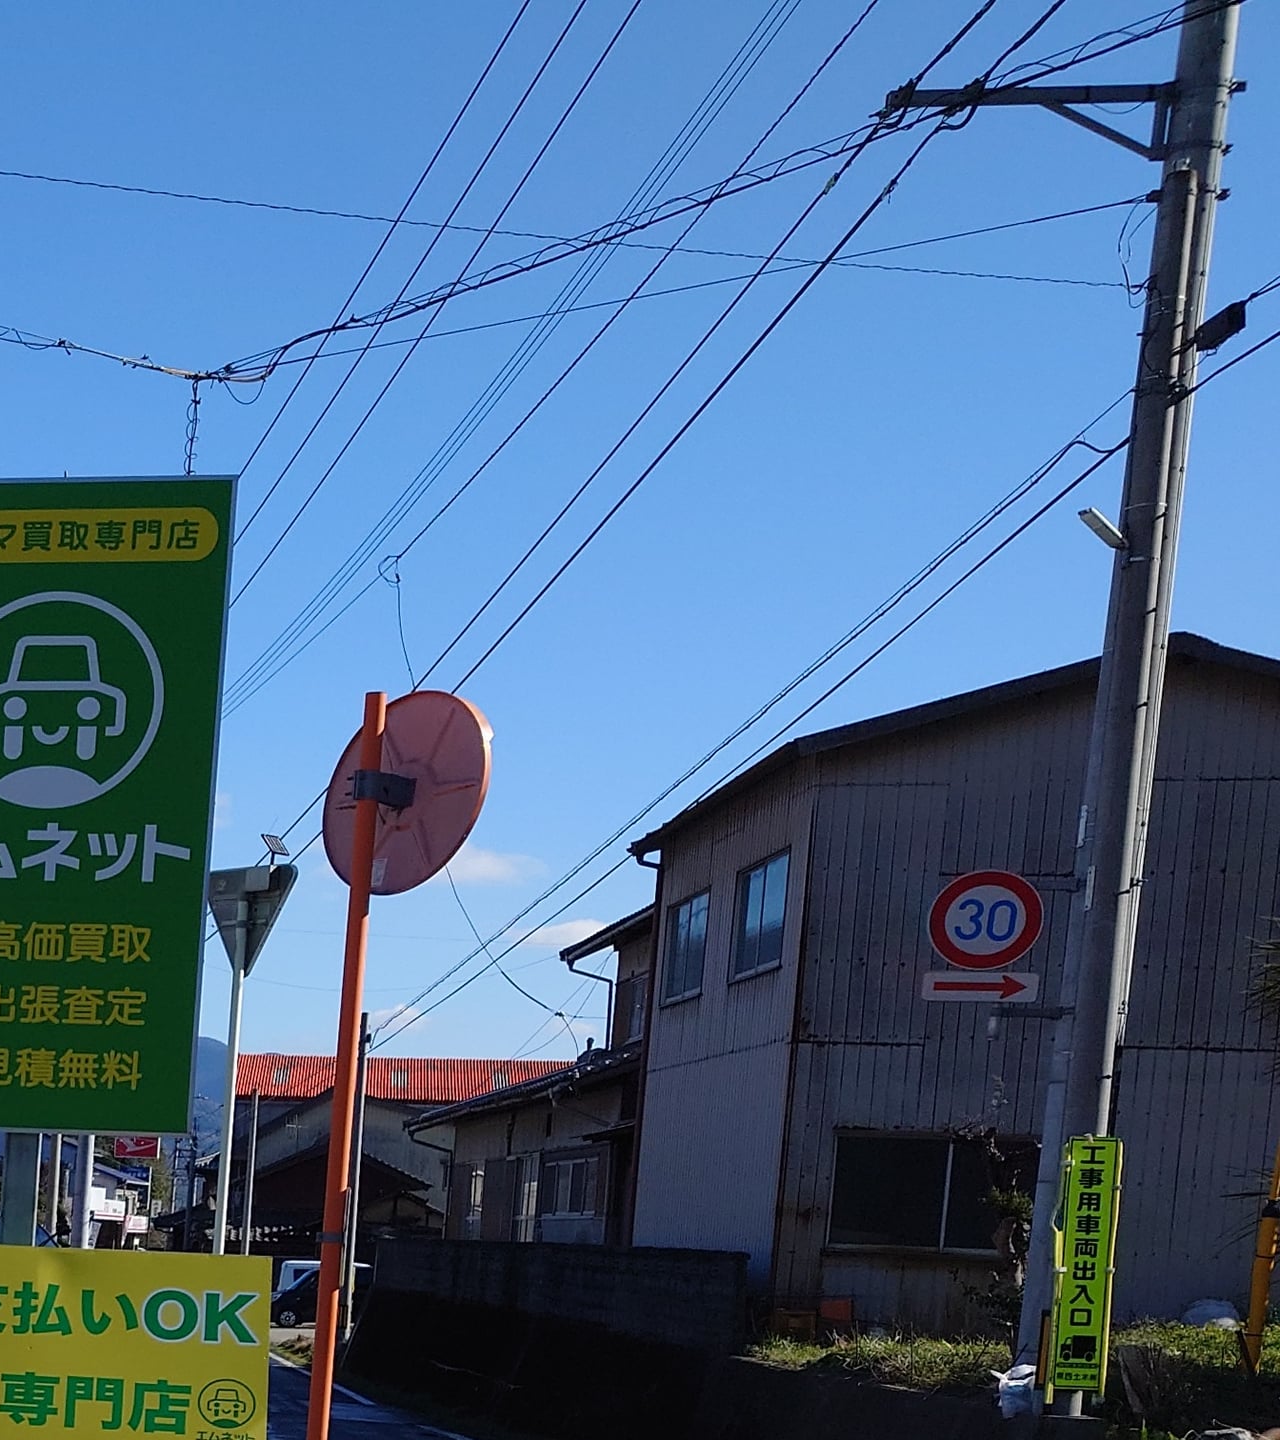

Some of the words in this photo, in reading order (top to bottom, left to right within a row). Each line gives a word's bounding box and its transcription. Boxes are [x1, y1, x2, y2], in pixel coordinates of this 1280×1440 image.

[954, 898, 1018, 942] 30
[1069, 1145, 1107, 1327] 工事用車両出入口
